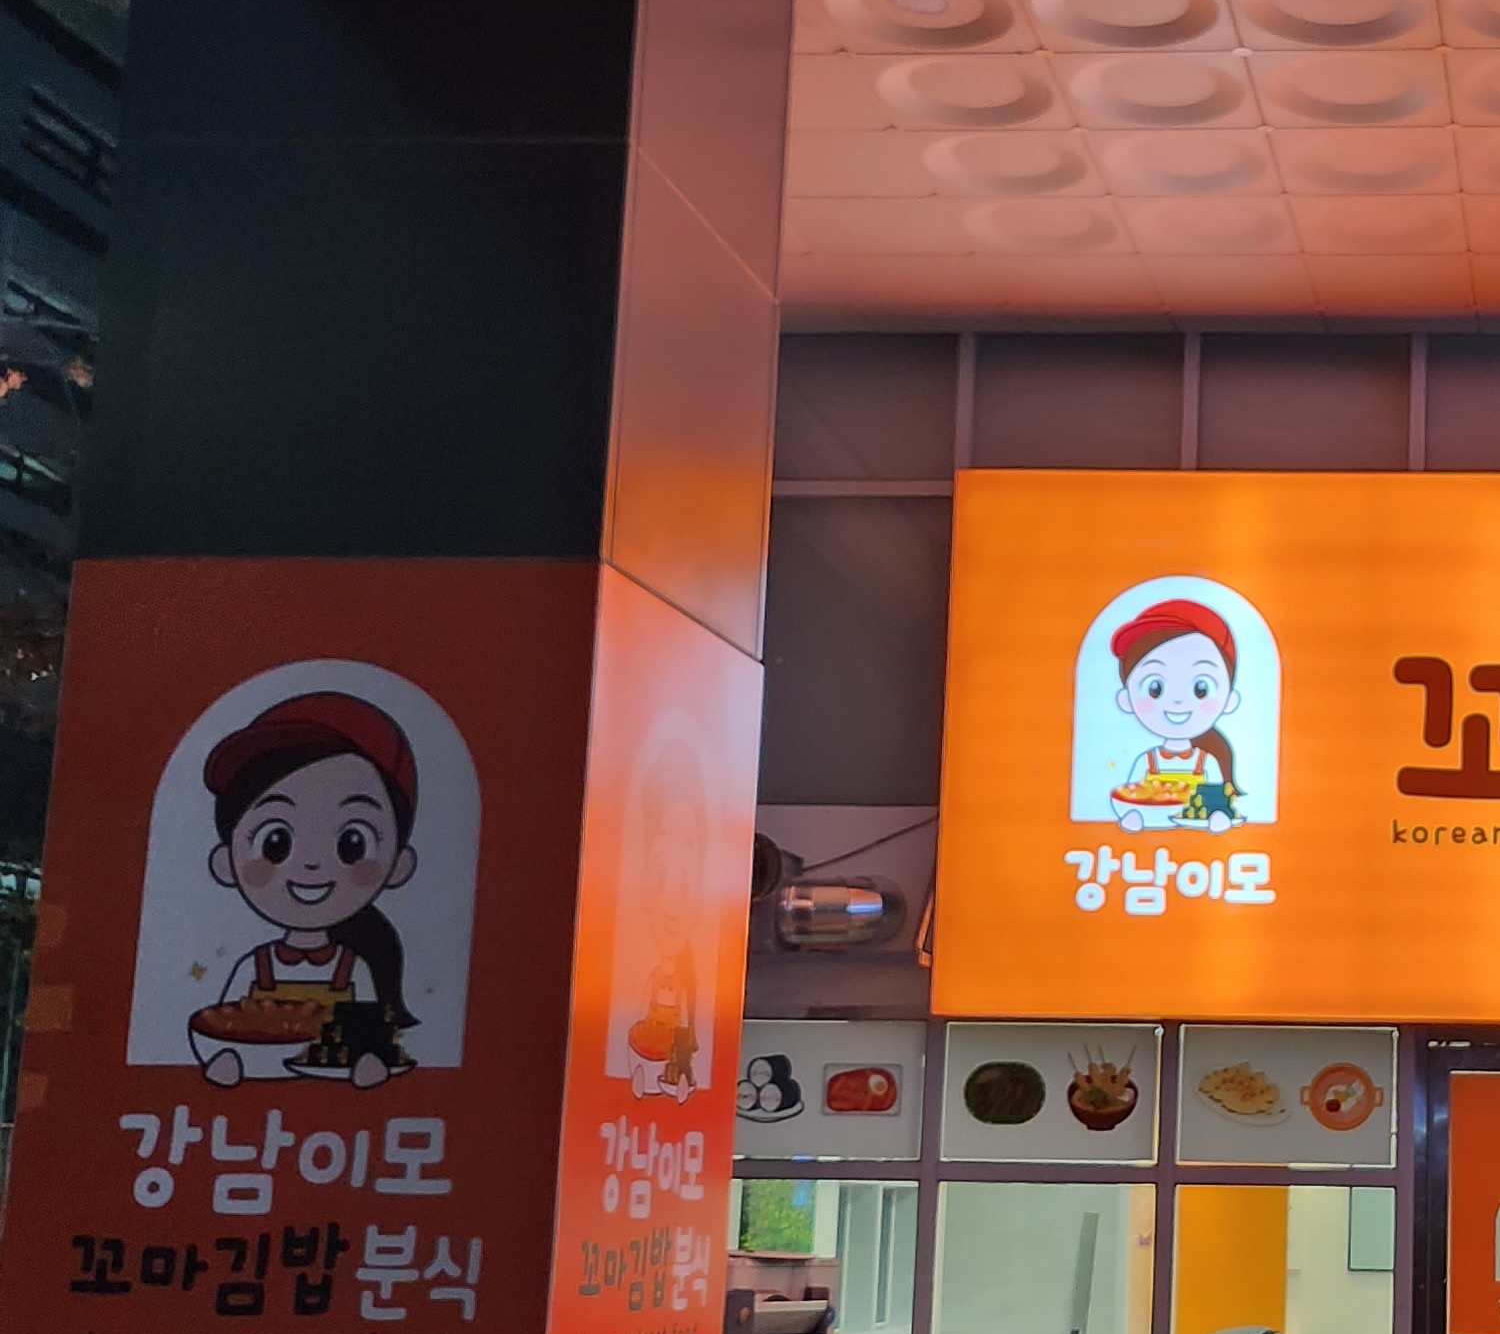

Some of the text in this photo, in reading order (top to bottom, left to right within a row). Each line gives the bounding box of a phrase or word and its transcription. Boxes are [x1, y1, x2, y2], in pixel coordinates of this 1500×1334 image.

[1064, 847, 1277, 916] 강남이모
[119, 1104, 452, 1215] 강남이모
[600, 1114, 704, 1220] 강남이모
